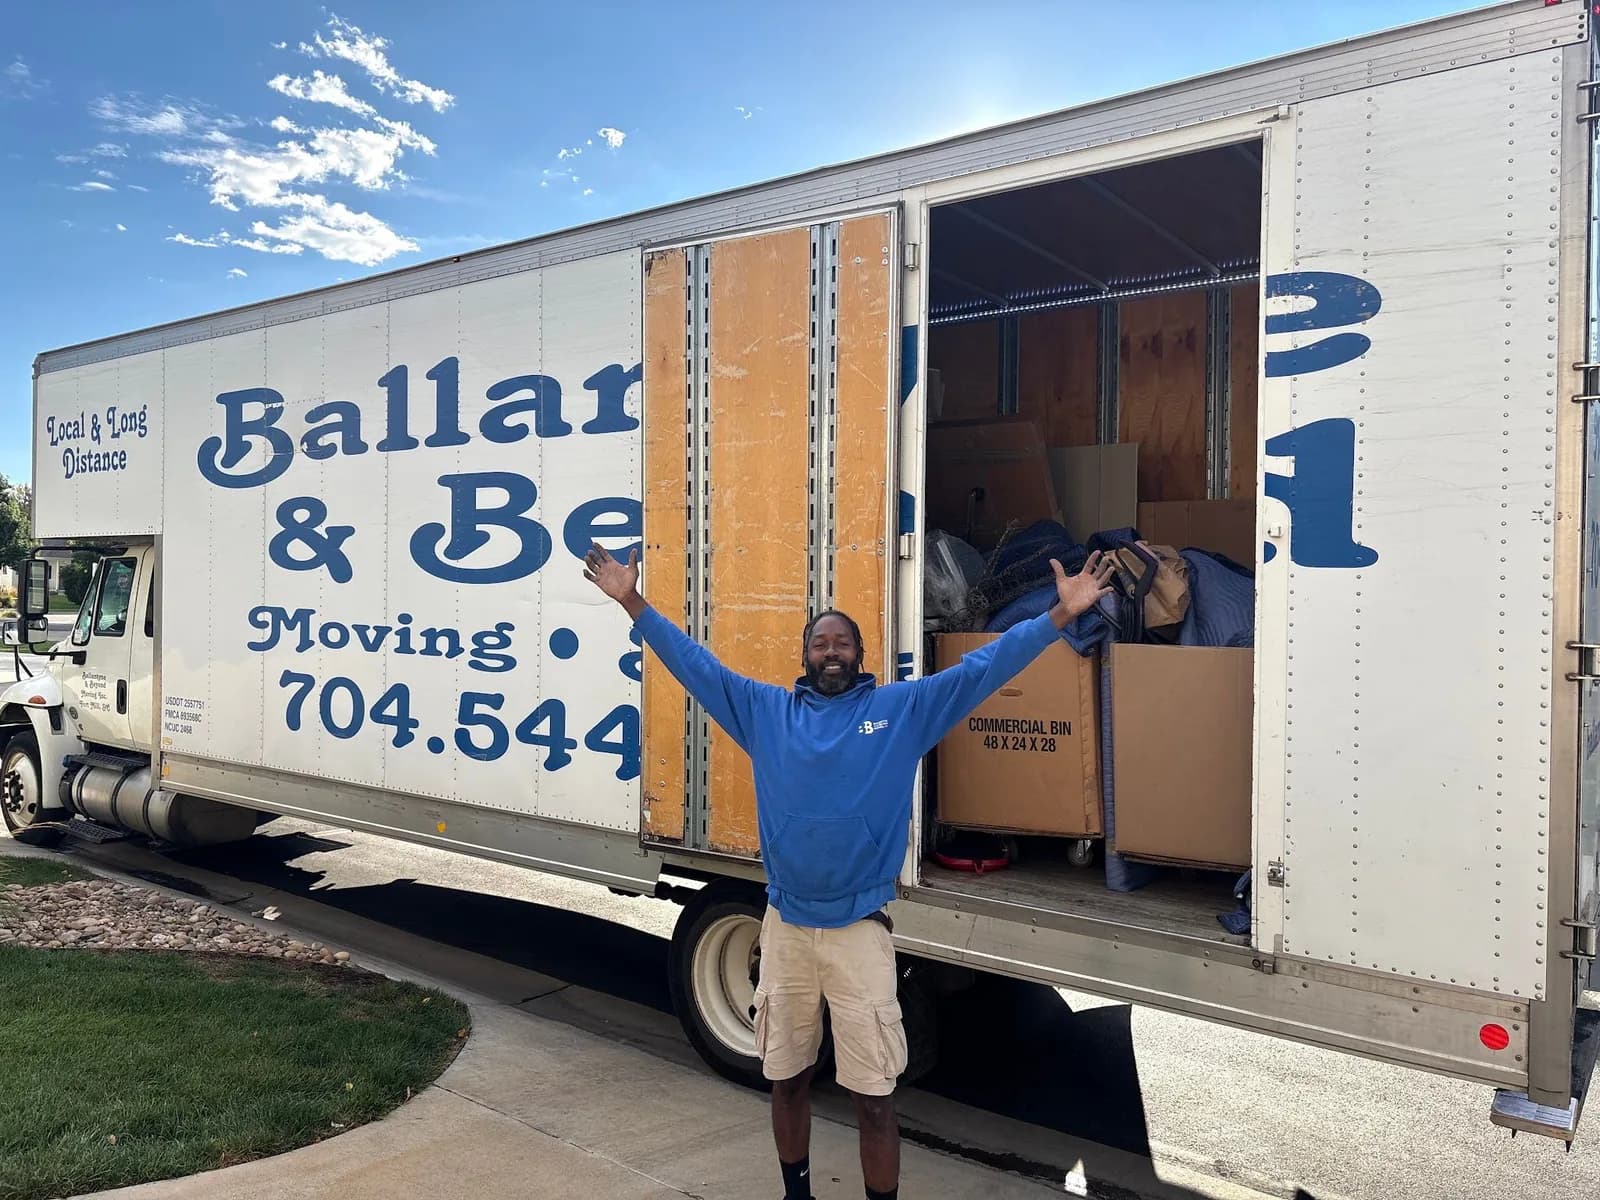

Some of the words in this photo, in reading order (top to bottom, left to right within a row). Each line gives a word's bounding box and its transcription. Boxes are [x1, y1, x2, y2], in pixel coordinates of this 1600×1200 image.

[46, 411, 86, 447] Local
[91, 413, 101, 446] &
[106, 404, 148, 438] Long
[62, 446, 127, 479] Distance
[268, 497, 355, 584] &
[247, 605, 517, 673] Moving
[969, 717, 1047, 735] COMMERCIAL
[1050, 720, 1072, 736] BIN
[984, 734, 999, 750] 48
[1001, 735, 1009, 751] X
[1012, 736, 1026, 751] 24
[1029, 737, 1038, 752] X
[1041, 737, 1056, 753] 28
